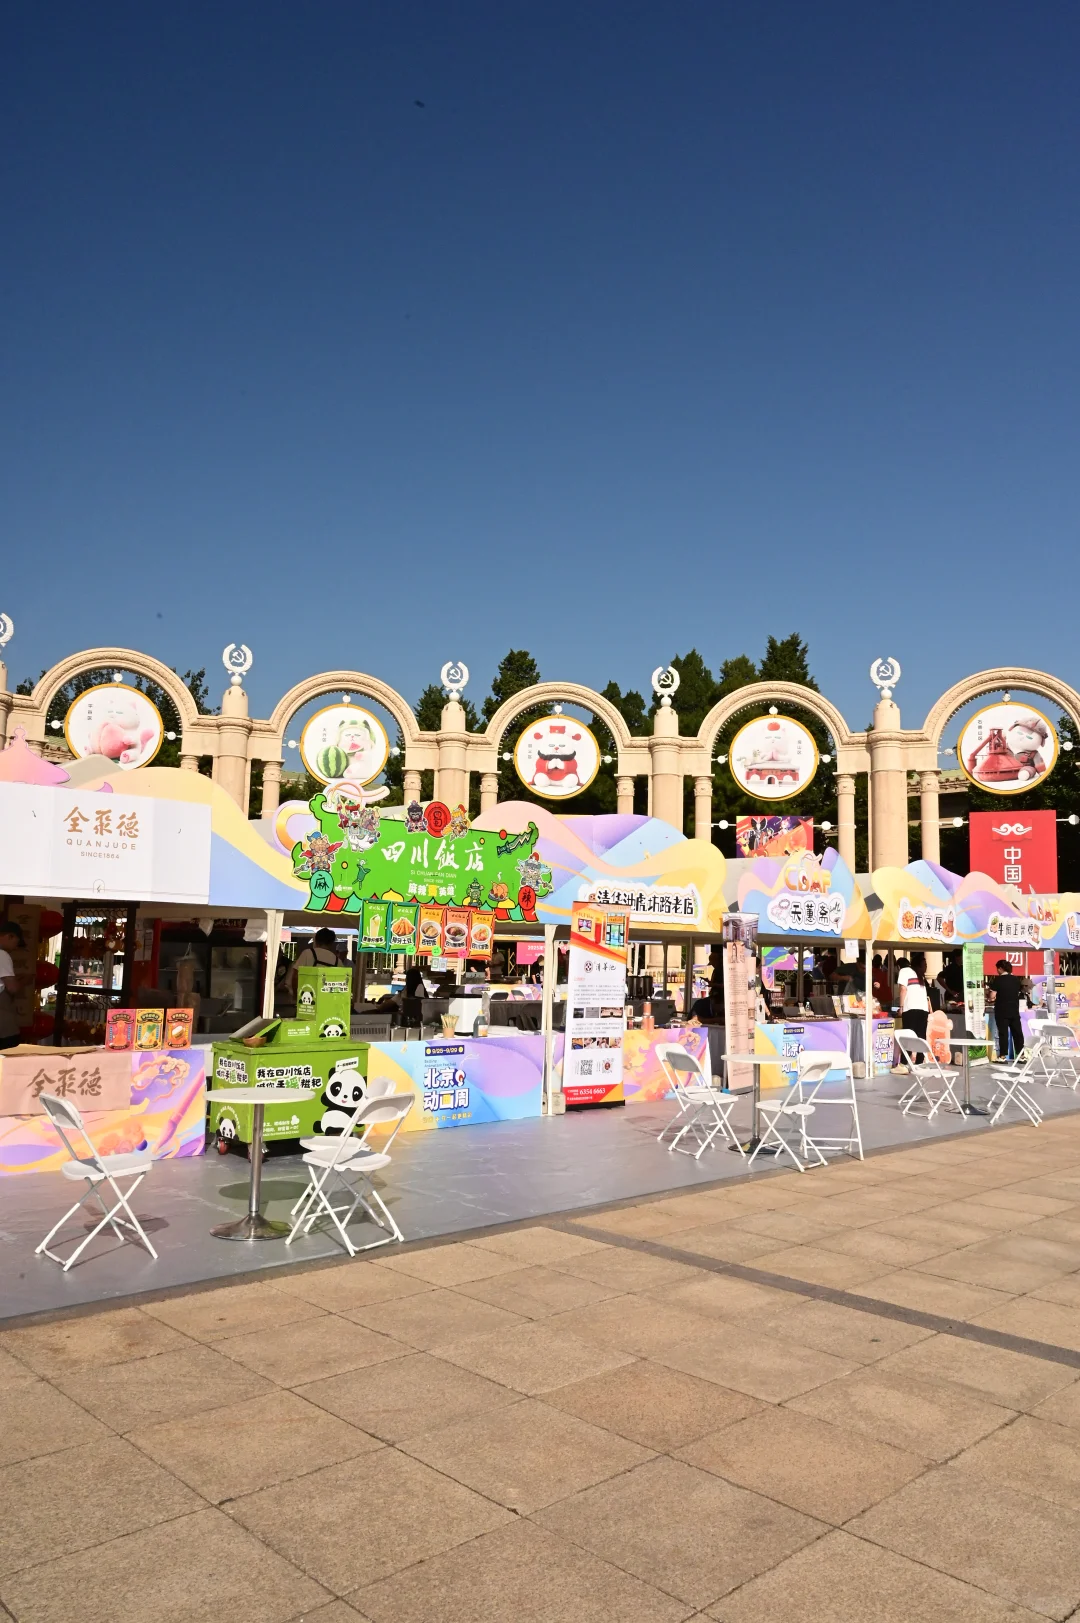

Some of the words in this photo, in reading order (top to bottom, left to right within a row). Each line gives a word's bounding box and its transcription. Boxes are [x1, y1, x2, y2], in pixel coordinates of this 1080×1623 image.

[63, 806, 139, 838] 全聚德
[66, 838, 137, 850] QUANJUDE
[80, 851, 120, 860] SINCE1864
[1004, 846, 1022, 894] 中国
[782, 1042, 800, 1057] 北京
[875, 1035, 890, 1050] 北京
[256, 1066, 312, 1079] 我在四川饭店
[423, 1067, 456, 1090] 北京
[27, 1067, 102, 1098] 全聚德
[423, 1087, 470, 1112] 动画周
